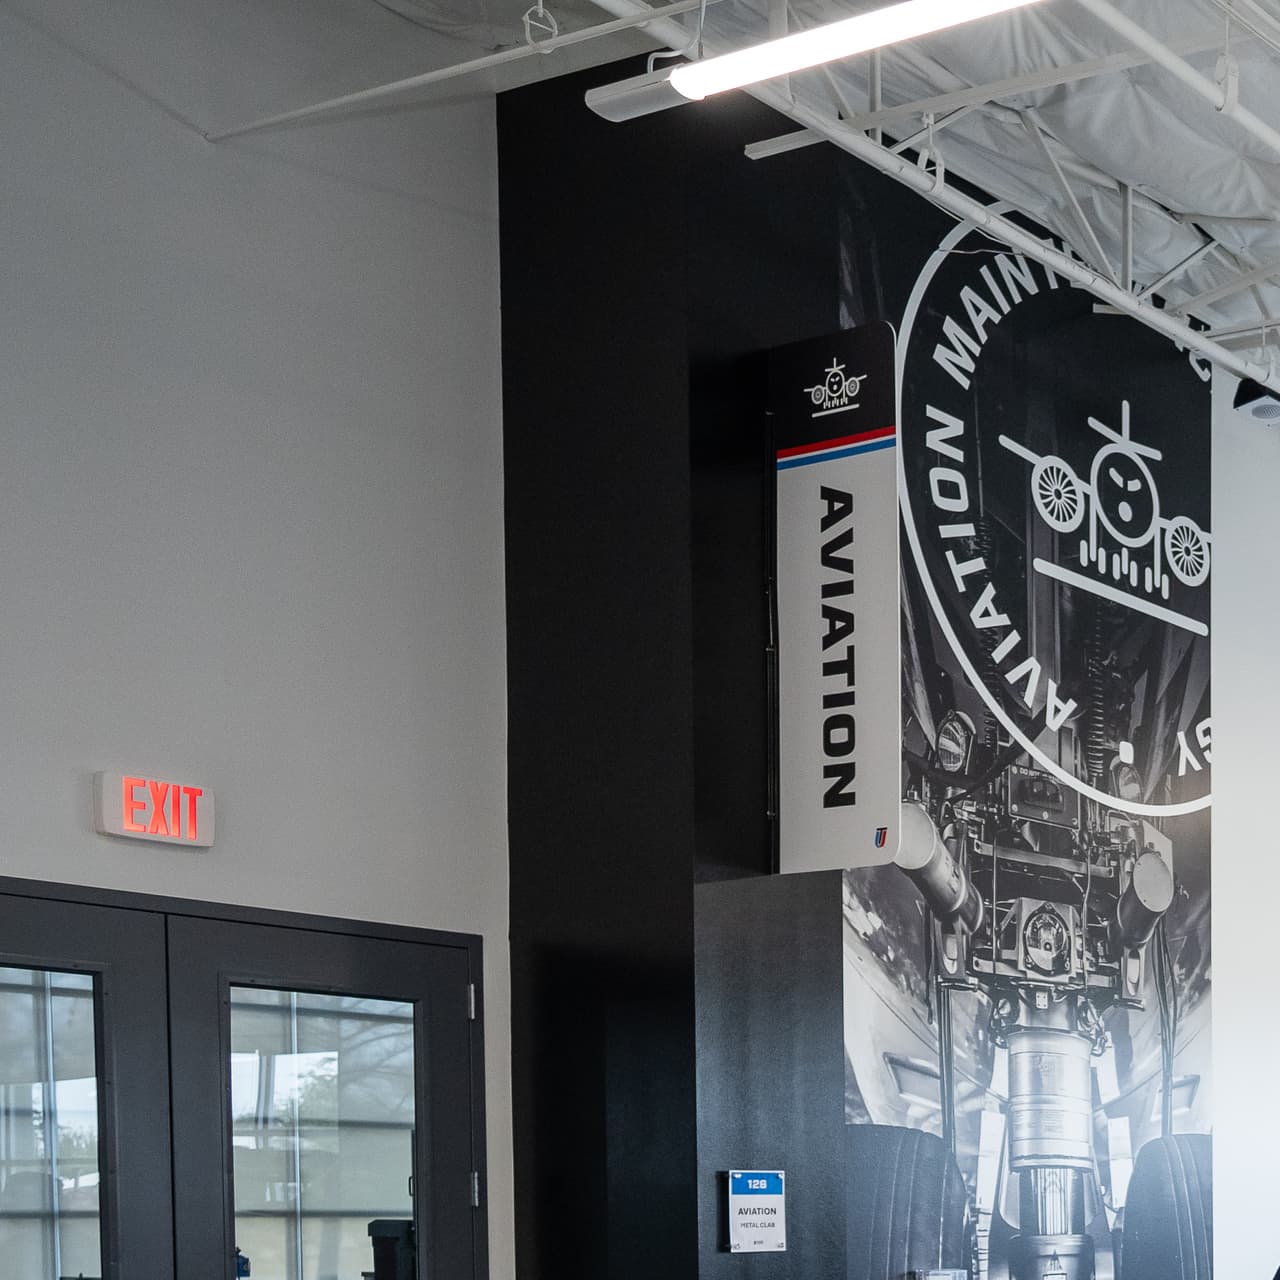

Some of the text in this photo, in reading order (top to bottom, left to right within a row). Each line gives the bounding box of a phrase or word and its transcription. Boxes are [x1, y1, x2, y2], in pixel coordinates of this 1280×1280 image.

[820, 485, 856, 809] AVIATION
[925, 406, 1078, 731] AVIATION
[122, 775, 203, 840] EXIT
[738, 1207, 777, 1216] AVIATION
